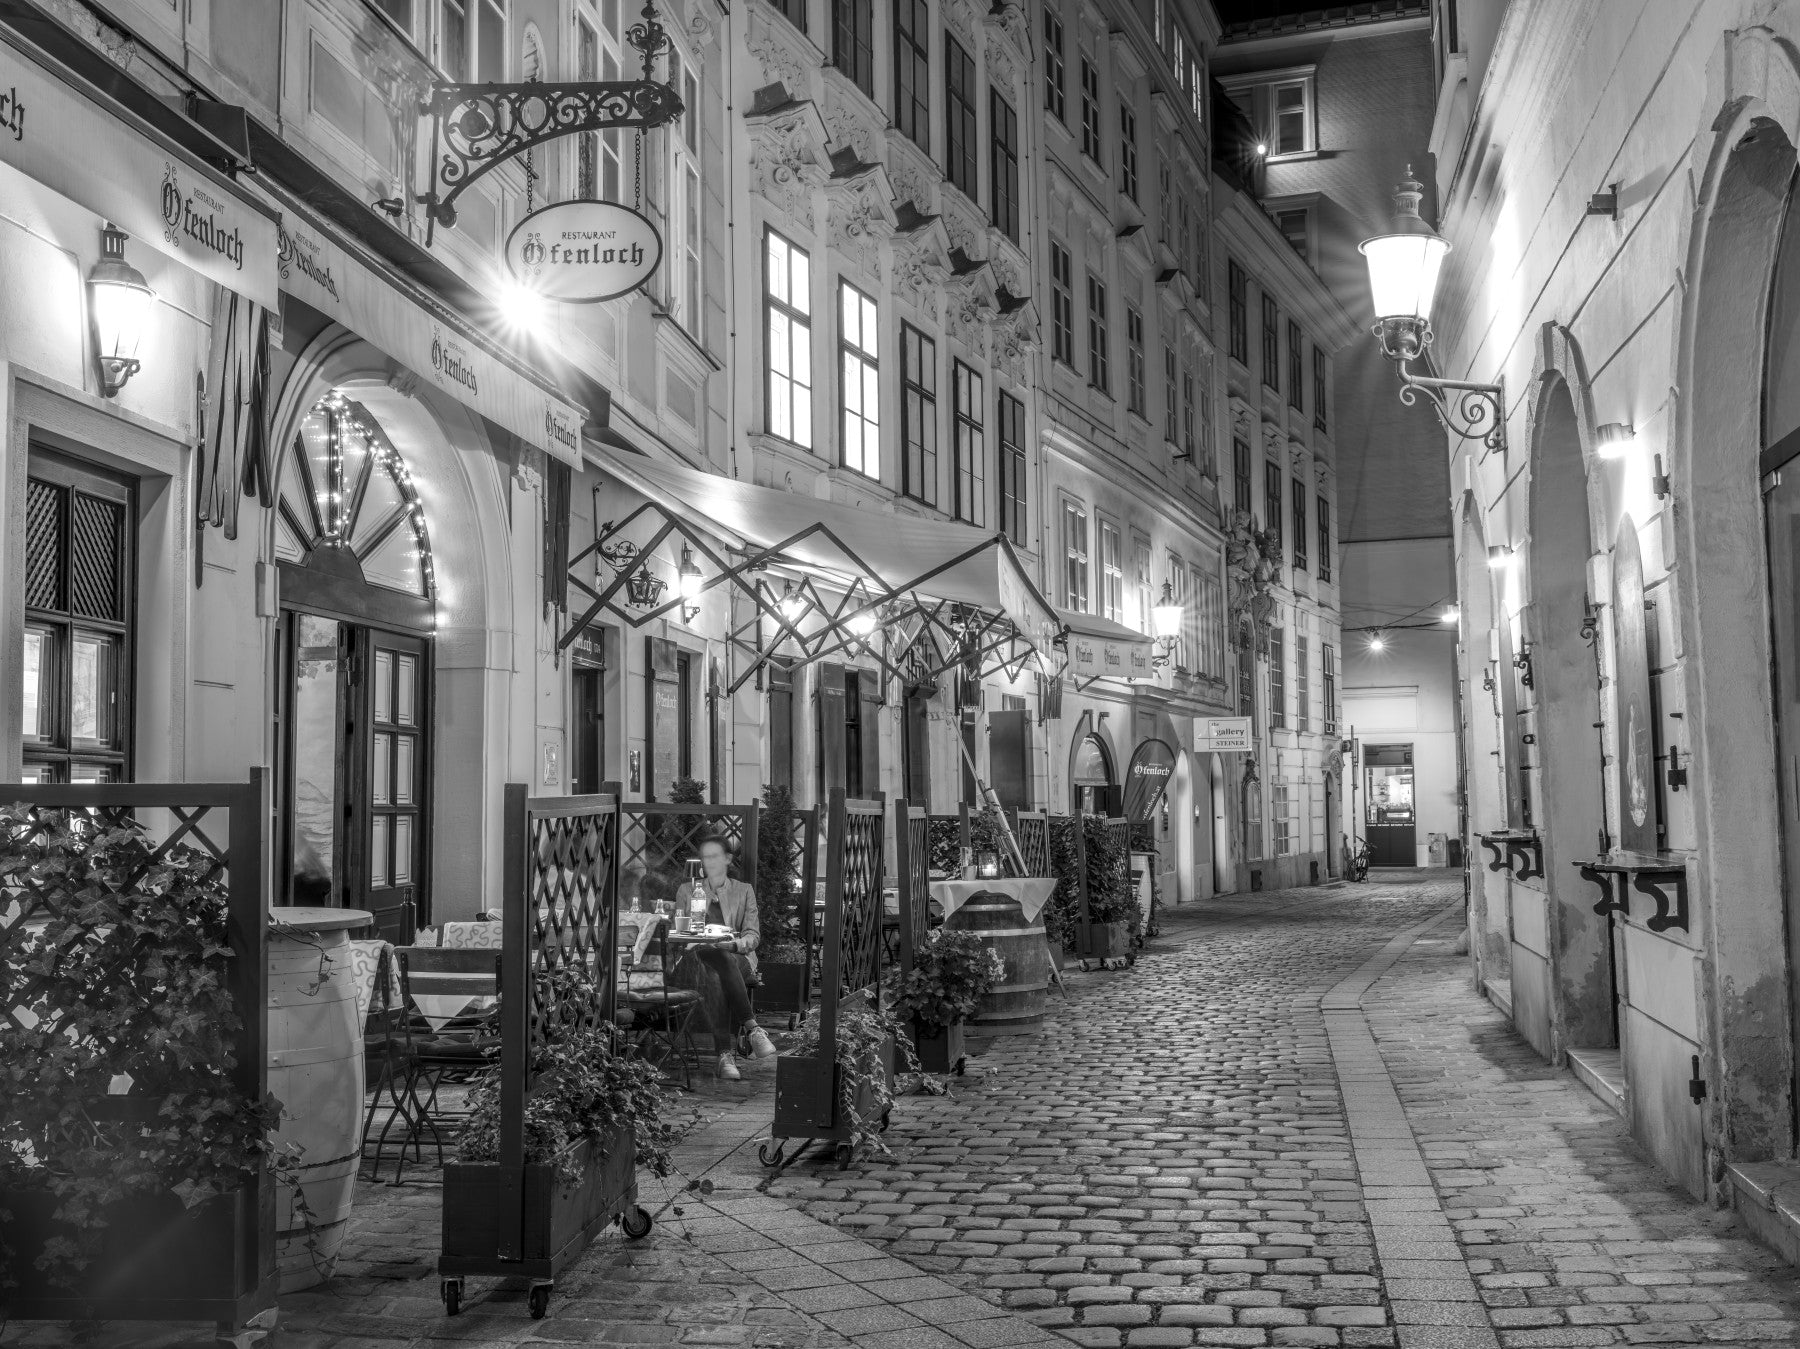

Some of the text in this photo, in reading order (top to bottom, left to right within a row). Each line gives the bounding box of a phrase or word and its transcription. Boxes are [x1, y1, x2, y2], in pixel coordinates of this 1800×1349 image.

[193, 187, 225, 214] RESTAURANT
[161, 182, 244, 270] Ofenloch
[562, 231, 616, 240] RESTAURANT
[521, 242, 644, 267] Ofenloch
[431, 339, 478, 396] Ofenloch
[1216, 728, 1244, 736] gallery
[1134, 764, 1170, 776] Ofenloch
